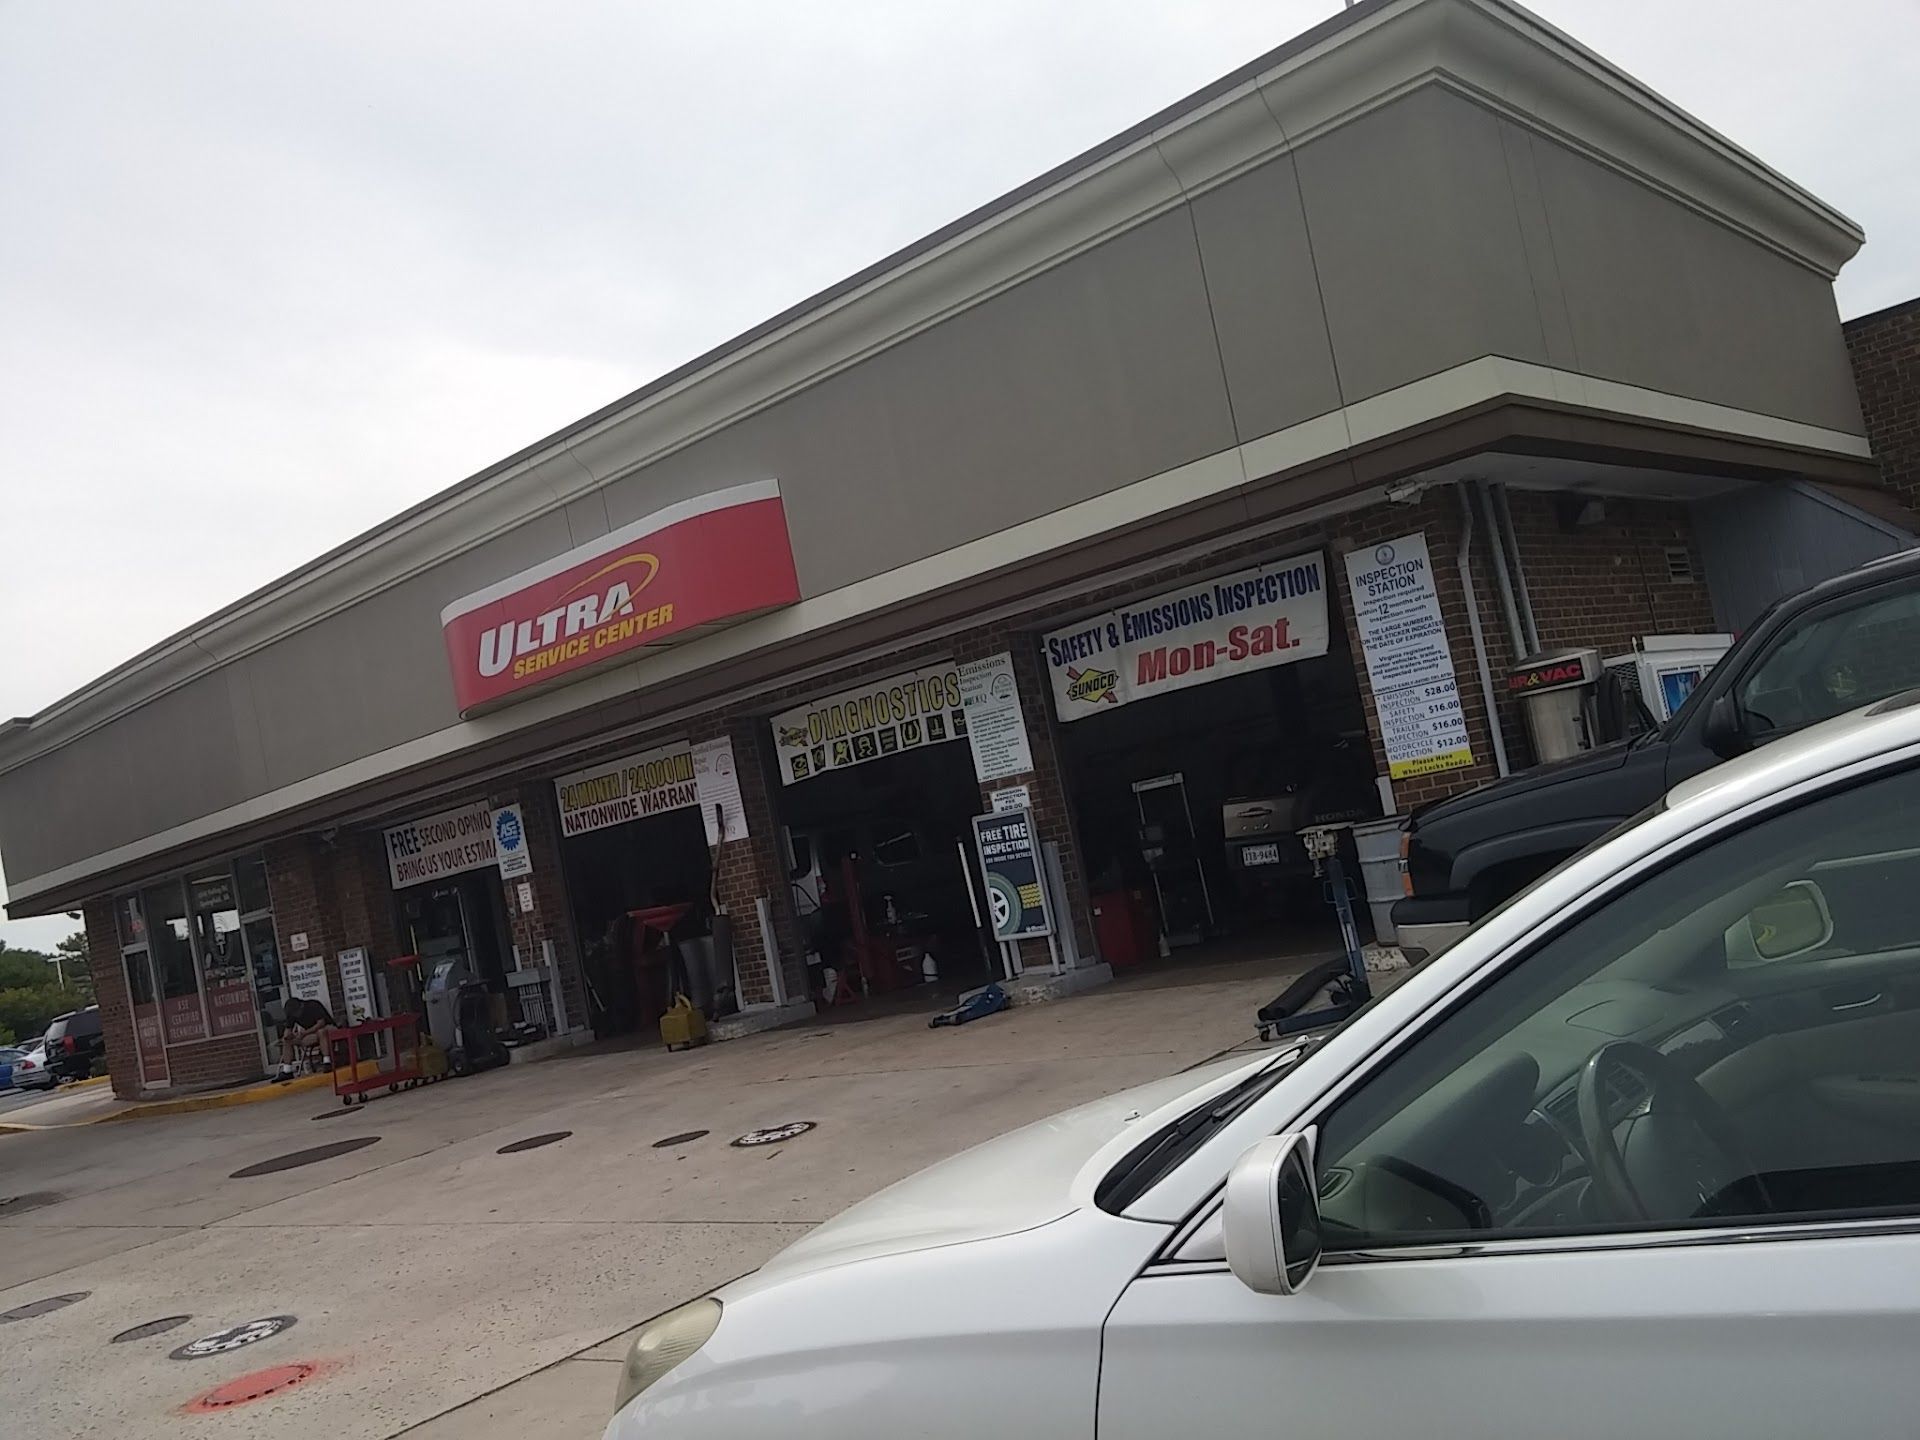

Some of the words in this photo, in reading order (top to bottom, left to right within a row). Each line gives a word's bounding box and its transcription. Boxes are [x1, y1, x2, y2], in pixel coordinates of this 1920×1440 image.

[1356, 558, 1423, 587] INSPECTION
[1368, 574, 1415, 596] STATION
[1397, 585, 1425, 597] required
[1357, 608, 1377, 617] within
[1378, 603, 1389, 615] 12
[1389, 599, 1413, 608] months
[1423, 592, 1434, 600] last
[1405, 604, 1426, 613] month
[1049, 626, 1102, 667] SAFETY
[1107, 622, 1120, 648] &
[1121, 592, 1213, 643] EMISSIONS
[1215, 563, 1321, 616] INSPECTION
[478, 580, 634, 677] ULTRA
[1368, 628, 1380, 636] THE
[1381, 625, 1401, 633] LARGE
[1402, 615, 1433, 627] NUMBERS
[1385, 628, 1410, 639] STICKER
[513, 634, 591, 680] SERVICE
[594, 603, 674, 649] CENTER
[1366, 643, 1378, 651] THE
[1379, 639, 1394, 648] DATE
[1405, 628, 1441, 641] EXPIRATION
[1137, 617, 1300, 686] Mon-Sat.
[1379, 652, 1401, 662] Virginia
[1403, 644, 1434, 657] registered
[957, 658, 1006, 676] Emissions
[960, 671, 991, 685] Inspection
[1071, 673, 1115, 698] SUNOCO
[961, 683, 983, 692] Station
[1383, 689, 1415, 701] EMISSION
[1425, 681, 1455, 696] $28.00
[808, 672, 960, 744] DIAGNOSTICS
[1380, 696, 1420, 709] INSPECTION
[1389, 707, 1415, 718] SAFETY
[1429, 700, 1459, 714] $16.00
[1384, 712, 1425, 726] INSPECTION
[1392, 723, 1420, 734] TRAILER
[1432, 718, 1463, 730] $16.00
[1387, 730, 1429, 743] INSPECTION
[1387, 739, 1433, 753] MOTORCYCLE
[1437, 735, 1468, 748] $12.00
[1391, 748, 1432, 761] INSPECTION
[1412, 757, 1434, 765] Please
[1402, 767, 1423, 775] Wheel
[1424, 762, 1443, 770] Locks
[560, 784, 578, 813] 24
[576, 772, 621, 808] MONTH
[629, 757, 674, 795] 24,000
[994, 793, 1026, 802] INSPECTION
[565, 798, 639, 833] NATIONWIDE
[640, 782, 698, 814] WARRAN
[1314, 808, 1366, 822] HONDA
[500, 820, 518, 838] ASE
[980, 829, 1003, 842] FREE
[1002, 823, 1027, 840] TIRE
[389, 826, 421, 859] FREE
[420, 820, 456, 847] SECOND
[983, 839, 1029, 855] INSPECTION
[397, 858, 426, 881] BRING
[425, 854, 438, 874] US
[438, 847, 466, 871] YOUR
[464, 838, 497, 863] ESTIM
